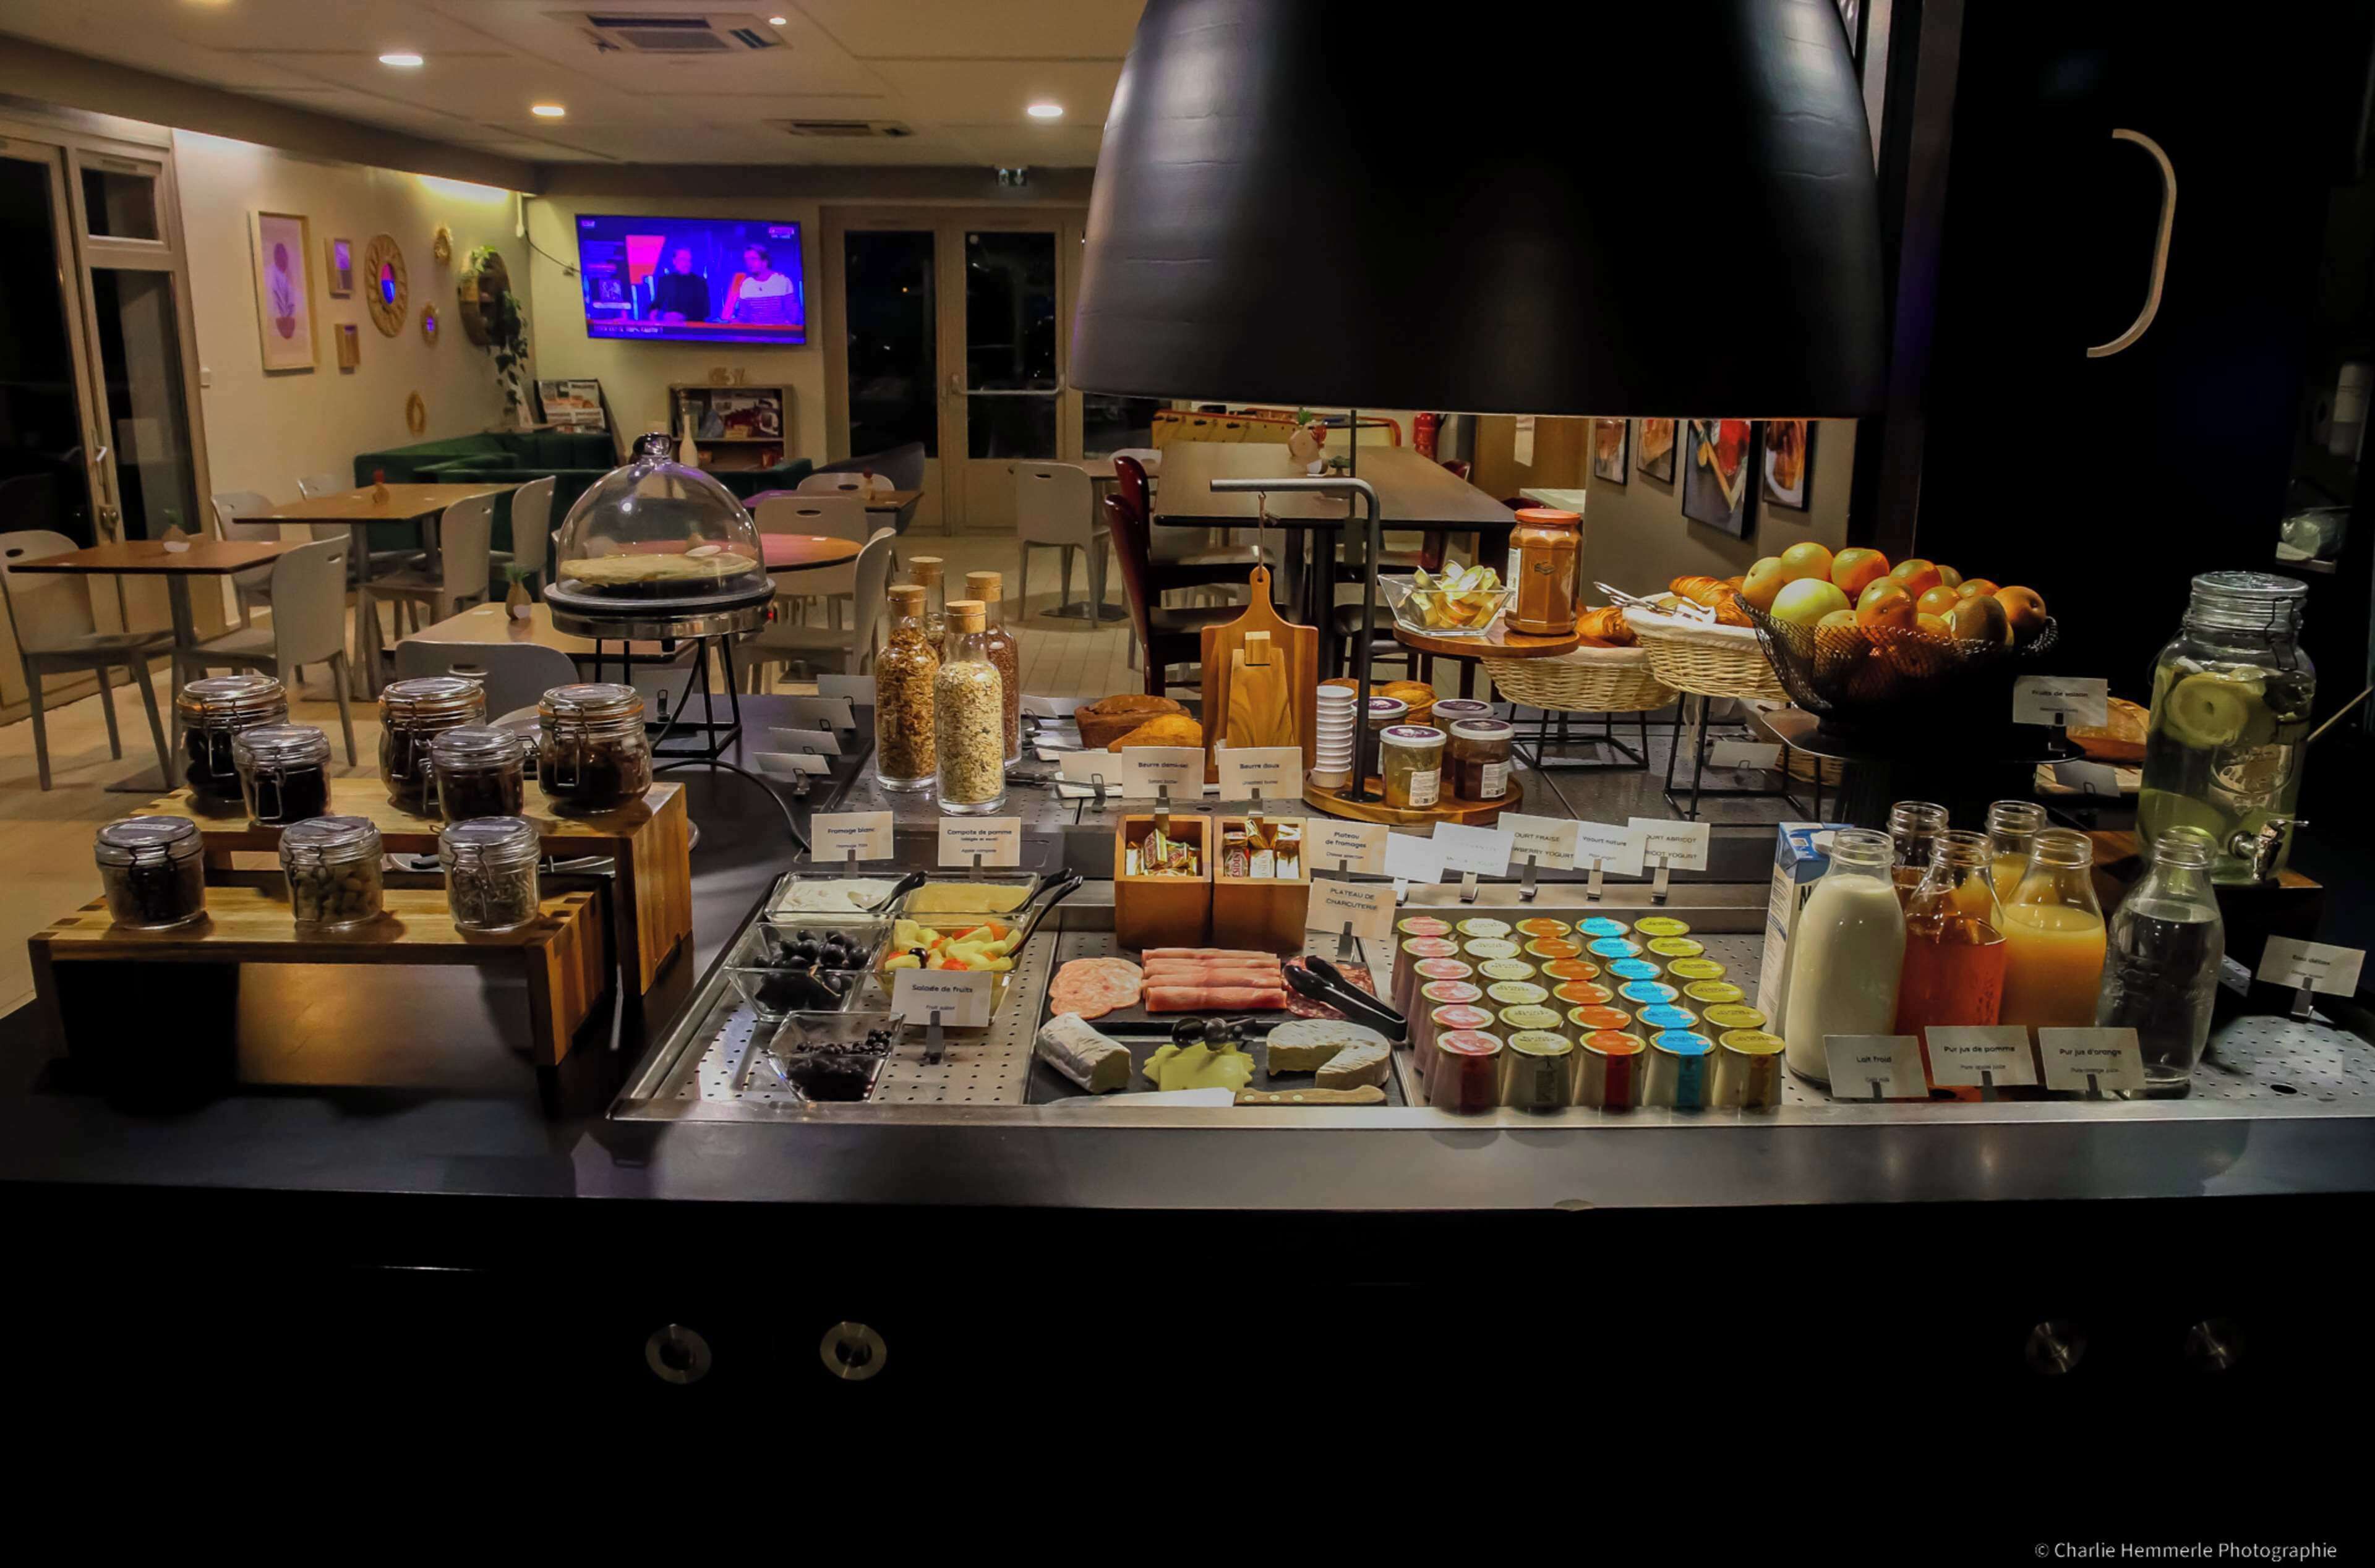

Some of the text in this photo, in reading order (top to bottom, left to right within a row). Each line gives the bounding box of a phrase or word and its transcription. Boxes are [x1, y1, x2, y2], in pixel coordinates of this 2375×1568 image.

[1334, 831, 1360, 840] Plateau
[1536, 834, 1560, 842] FRAISE
[1335, 840, 1367, 849] fromages
[1512, 846, 1575, 859] WBERRY YOGURT
[1330, 887, 1363, 899] PLATEAU
[1325, 898, 1378, 911] CHARCUTERIE
[912, 984, 939, 992] Salade
[1943, 1046, 1957, 1054] Pur
[1959, 1046, 1971, 1054] jus
[2074, 1049, 2085, 1057] jus
[2087, 1049, 2123, 1057] d'orange
[1856, 1055, 1892, 1063] Lait froid
